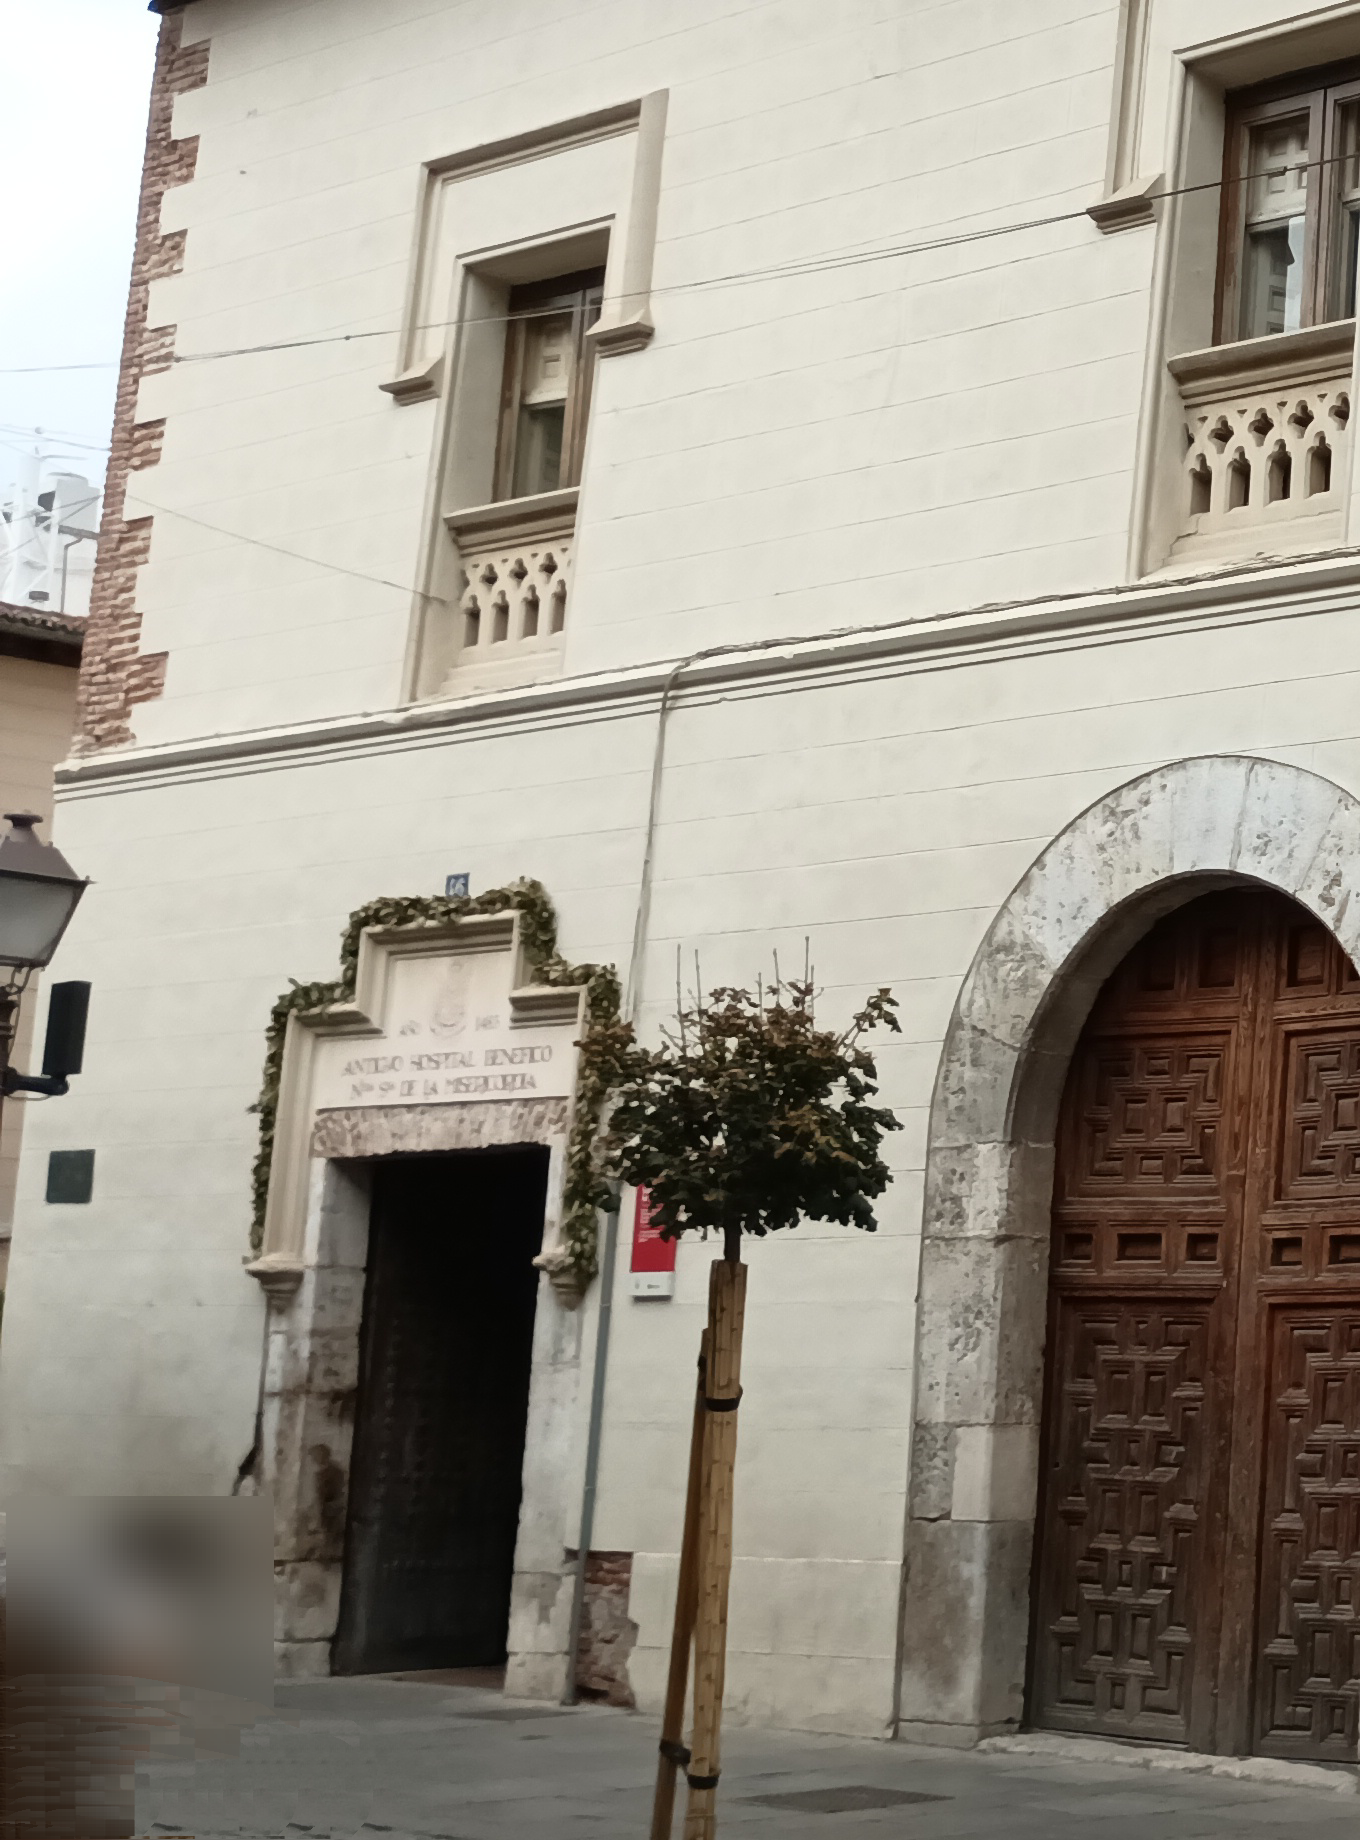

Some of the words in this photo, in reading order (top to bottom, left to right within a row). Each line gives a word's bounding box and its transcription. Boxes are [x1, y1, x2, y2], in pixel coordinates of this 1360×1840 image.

[341, 1055, 404, 1077] ANTIGUO
[410, 1050, 476, 1072] HOSPITAL
[400, 1078, 418, 1098] DE
[423, 1078, 439, 1098] LA
[445, 1072, 537, 1095] MISERICORDIA
